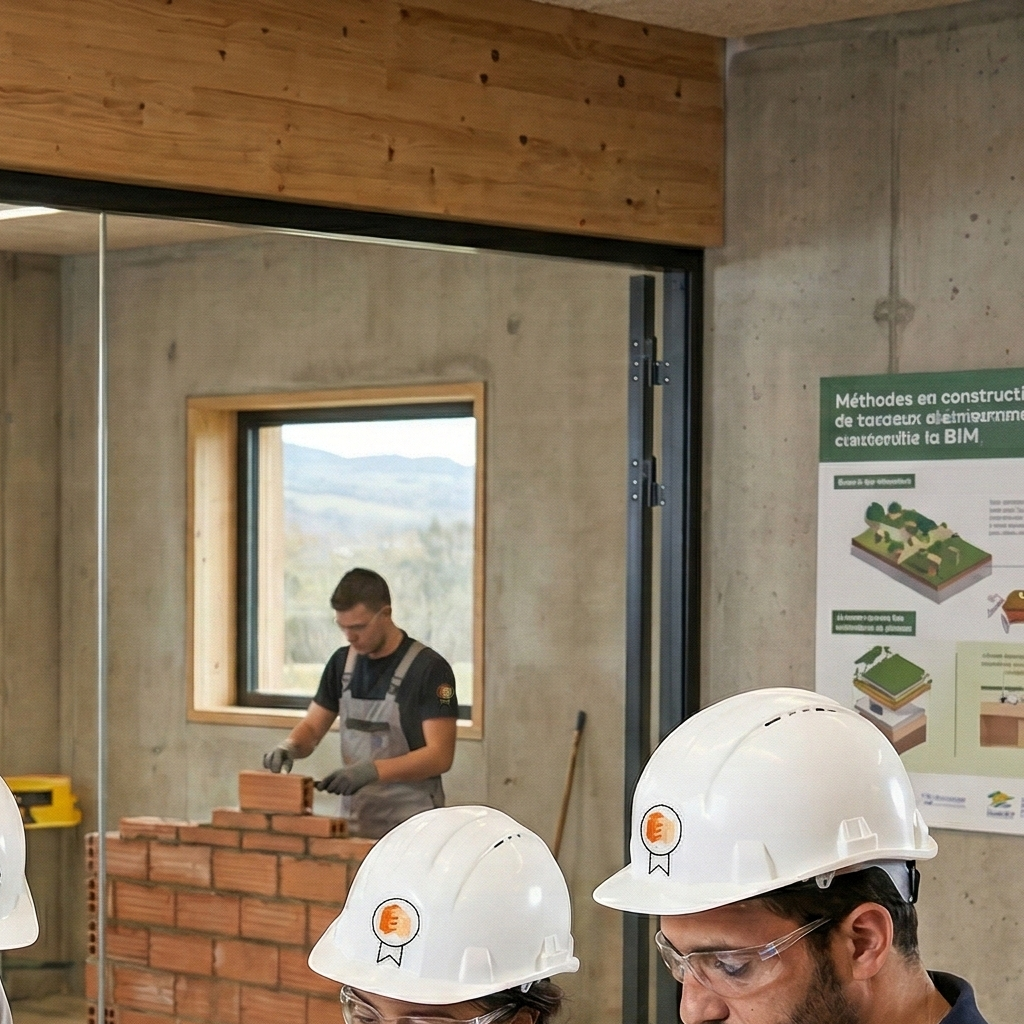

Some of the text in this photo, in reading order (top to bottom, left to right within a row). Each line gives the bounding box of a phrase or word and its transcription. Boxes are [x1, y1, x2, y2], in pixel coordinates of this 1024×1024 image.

[835, 391, 914, 409] Méthodes
[834, 413, 854, 428] de
[944, 427, 980, 445] BIM
